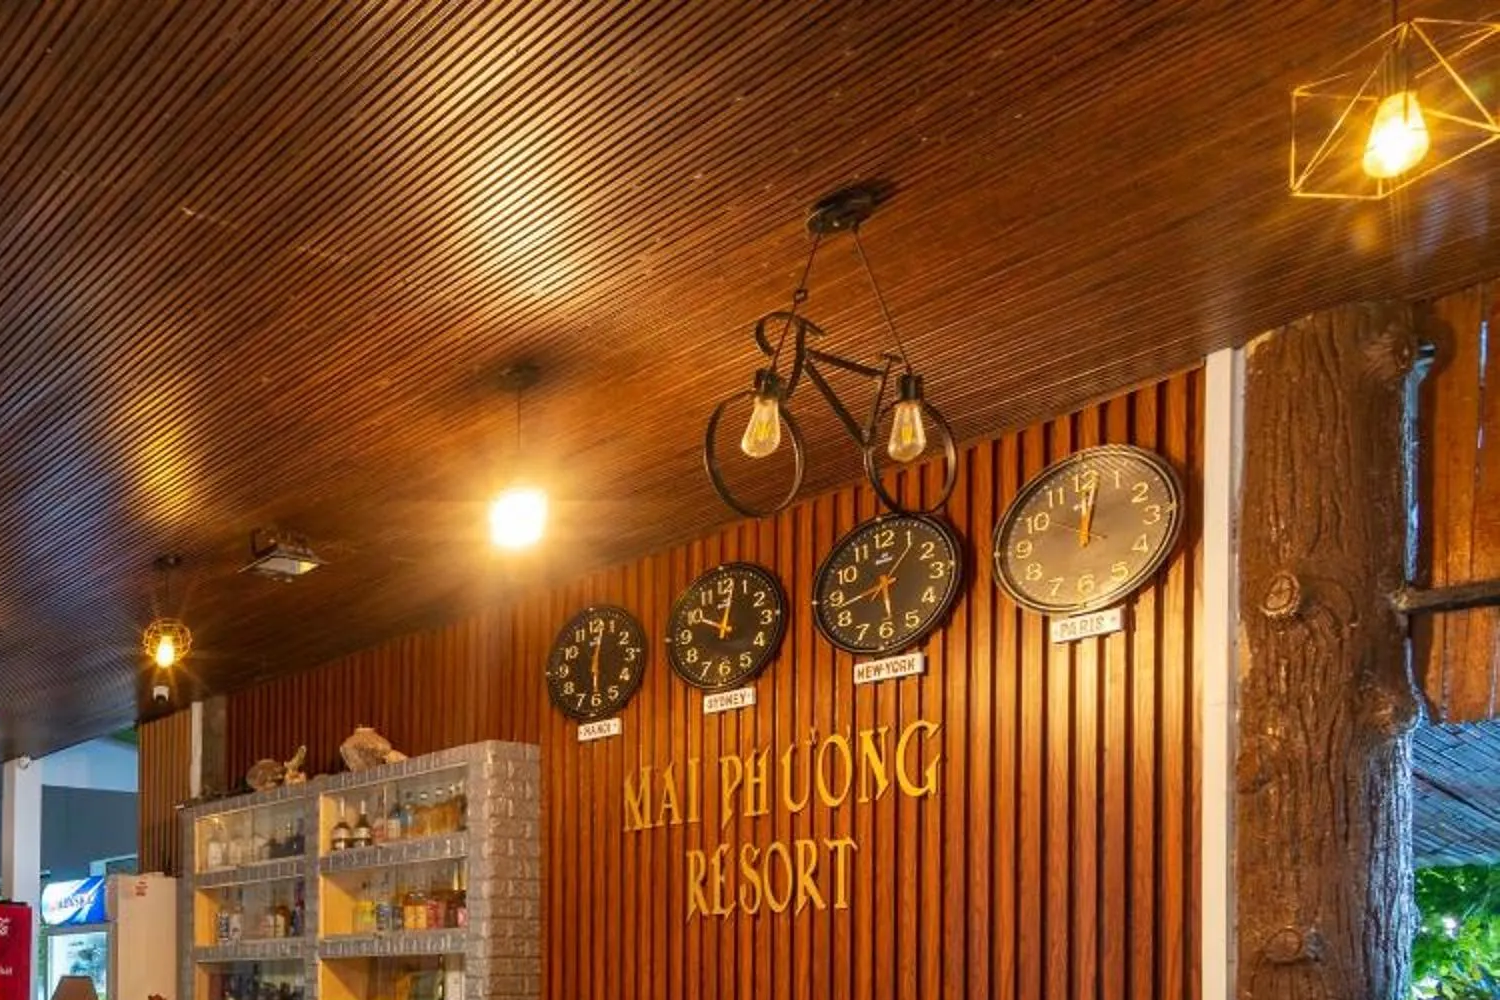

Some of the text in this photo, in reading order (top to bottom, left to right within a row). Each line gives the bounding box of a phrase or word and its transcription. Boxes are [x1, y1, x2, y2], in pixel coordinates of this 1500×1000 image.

[1072, 470, 1099, 493] 12
[1114, 470, 1120, 489] 1
[1046, 487, 1064, 509] 11
[1131, 482, 1149, 503] 2
[1025, 511, 1049, 535] 10
[1142, 504, 1161, 525] 3
[873, 529, 895, 549] 12
[906, 530, 912, 546] 1
[1131, 533, 1149, 553] 4
[854, 544, 869, 563] 11
[920, 541, 935, 561] 2
[1015, 540, 1033, 559] 9
[837, 565, 858, 585] 10
[929, 561, 945, 579] 3
[1026, 563, 1043, 582] 8
[1111, 562, 1129, 581] 5
[717, 577, 734, 595] 12
[742, 579, 748, 594] 1
[1048, 577, 1064, 597] 7
[1077, 573, 1095, 594] 6
[701, 589, 713, 606] 11
[753, 591, 766, 607] 2
[829, 590, 845, 608] 9
[921, 586, 936, 603] 4
[687, 607, 704, 625] 10
[760, 609, 773, 625] 3
[837, 610, 852, 627] 8
[905, 609, 920, 629] 5
[589, 619, 604, 633] 12
[610, 620, 615, 633] 1
[855, 623, 870, 644] 7
[879, 621, 894, 638] 6
[1060, 615, 1104, 638] PARIS
[576, 628, 585, 643] 11
[620, 631, 629, 645] 2
[680, 629, 693, 645] 9
[753, 631, 765, 647] 4
[565, 645, 579, 660] 10
[625, 647, 635, 661] 3
[686, 648, 698, 663] 8
[740, 652, 752, 668] 5
[560, 664, 569, 678] 9
[620, 667, 630, 681] 4
[700, 661, 712, 680] 7
[719, 661, 731, 676] 6
[564, 681, 574, 694] 8
[608, 686, 619, 700] 5
[577, 694, 586, 711] 7
[591, 694, 601, 707] 6
[623, 757, 700, 832] MAI
[686, 836, 858, 924] RESORT
